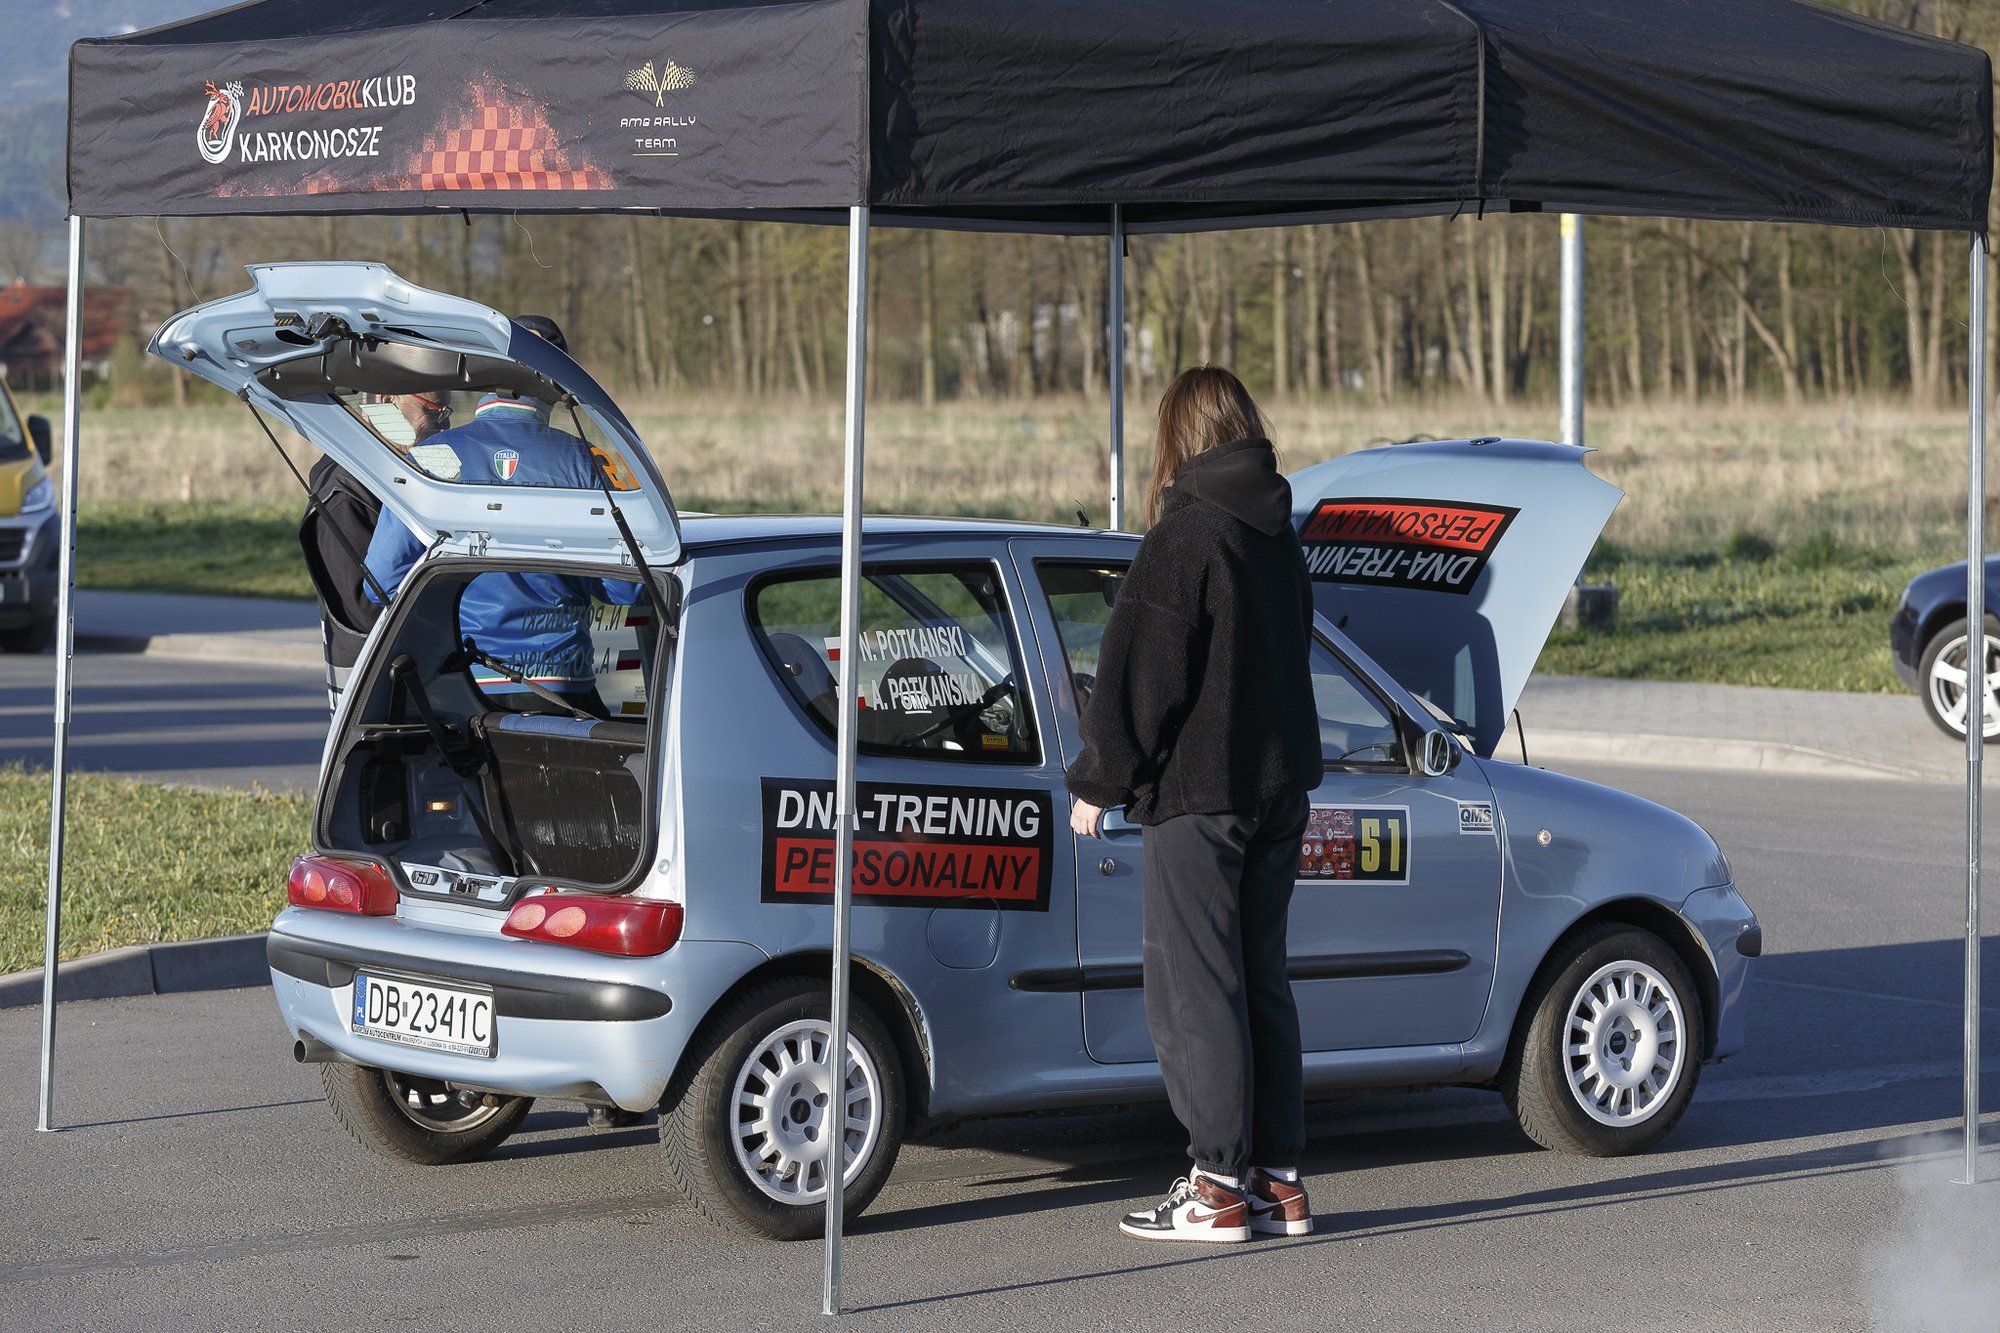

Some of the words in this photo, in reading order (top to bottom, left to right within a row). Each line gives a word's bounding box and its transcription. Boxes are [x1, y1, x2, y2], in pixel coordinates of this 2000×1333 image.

[246, 75, 416, 117] AUTOMOBILKLUB
[653, 116, 696, 126] RALLY
[239, 127, 383, 162] KARKONOSZE
[635, 138, 677, 148] TEAM
[1312, 509, 1496, 543] PERSONALNY
[858, 631, 877, 662] N.
[876, 626, 966, 660] POTKANSKI
[871, 680, 888, 711] A.
[888, 667, 985, 709] POTKAŃSKA
[776, 789, 1040, 839] DN-TRENING
[1461, 809, 1492, 823] QMS
[1361, 818, 1399, 872] 51
[356, 1006, 364, 1018] PL
[369, 983, 400, 1027] DB
[409, 990, 488, 1042] 2341C
